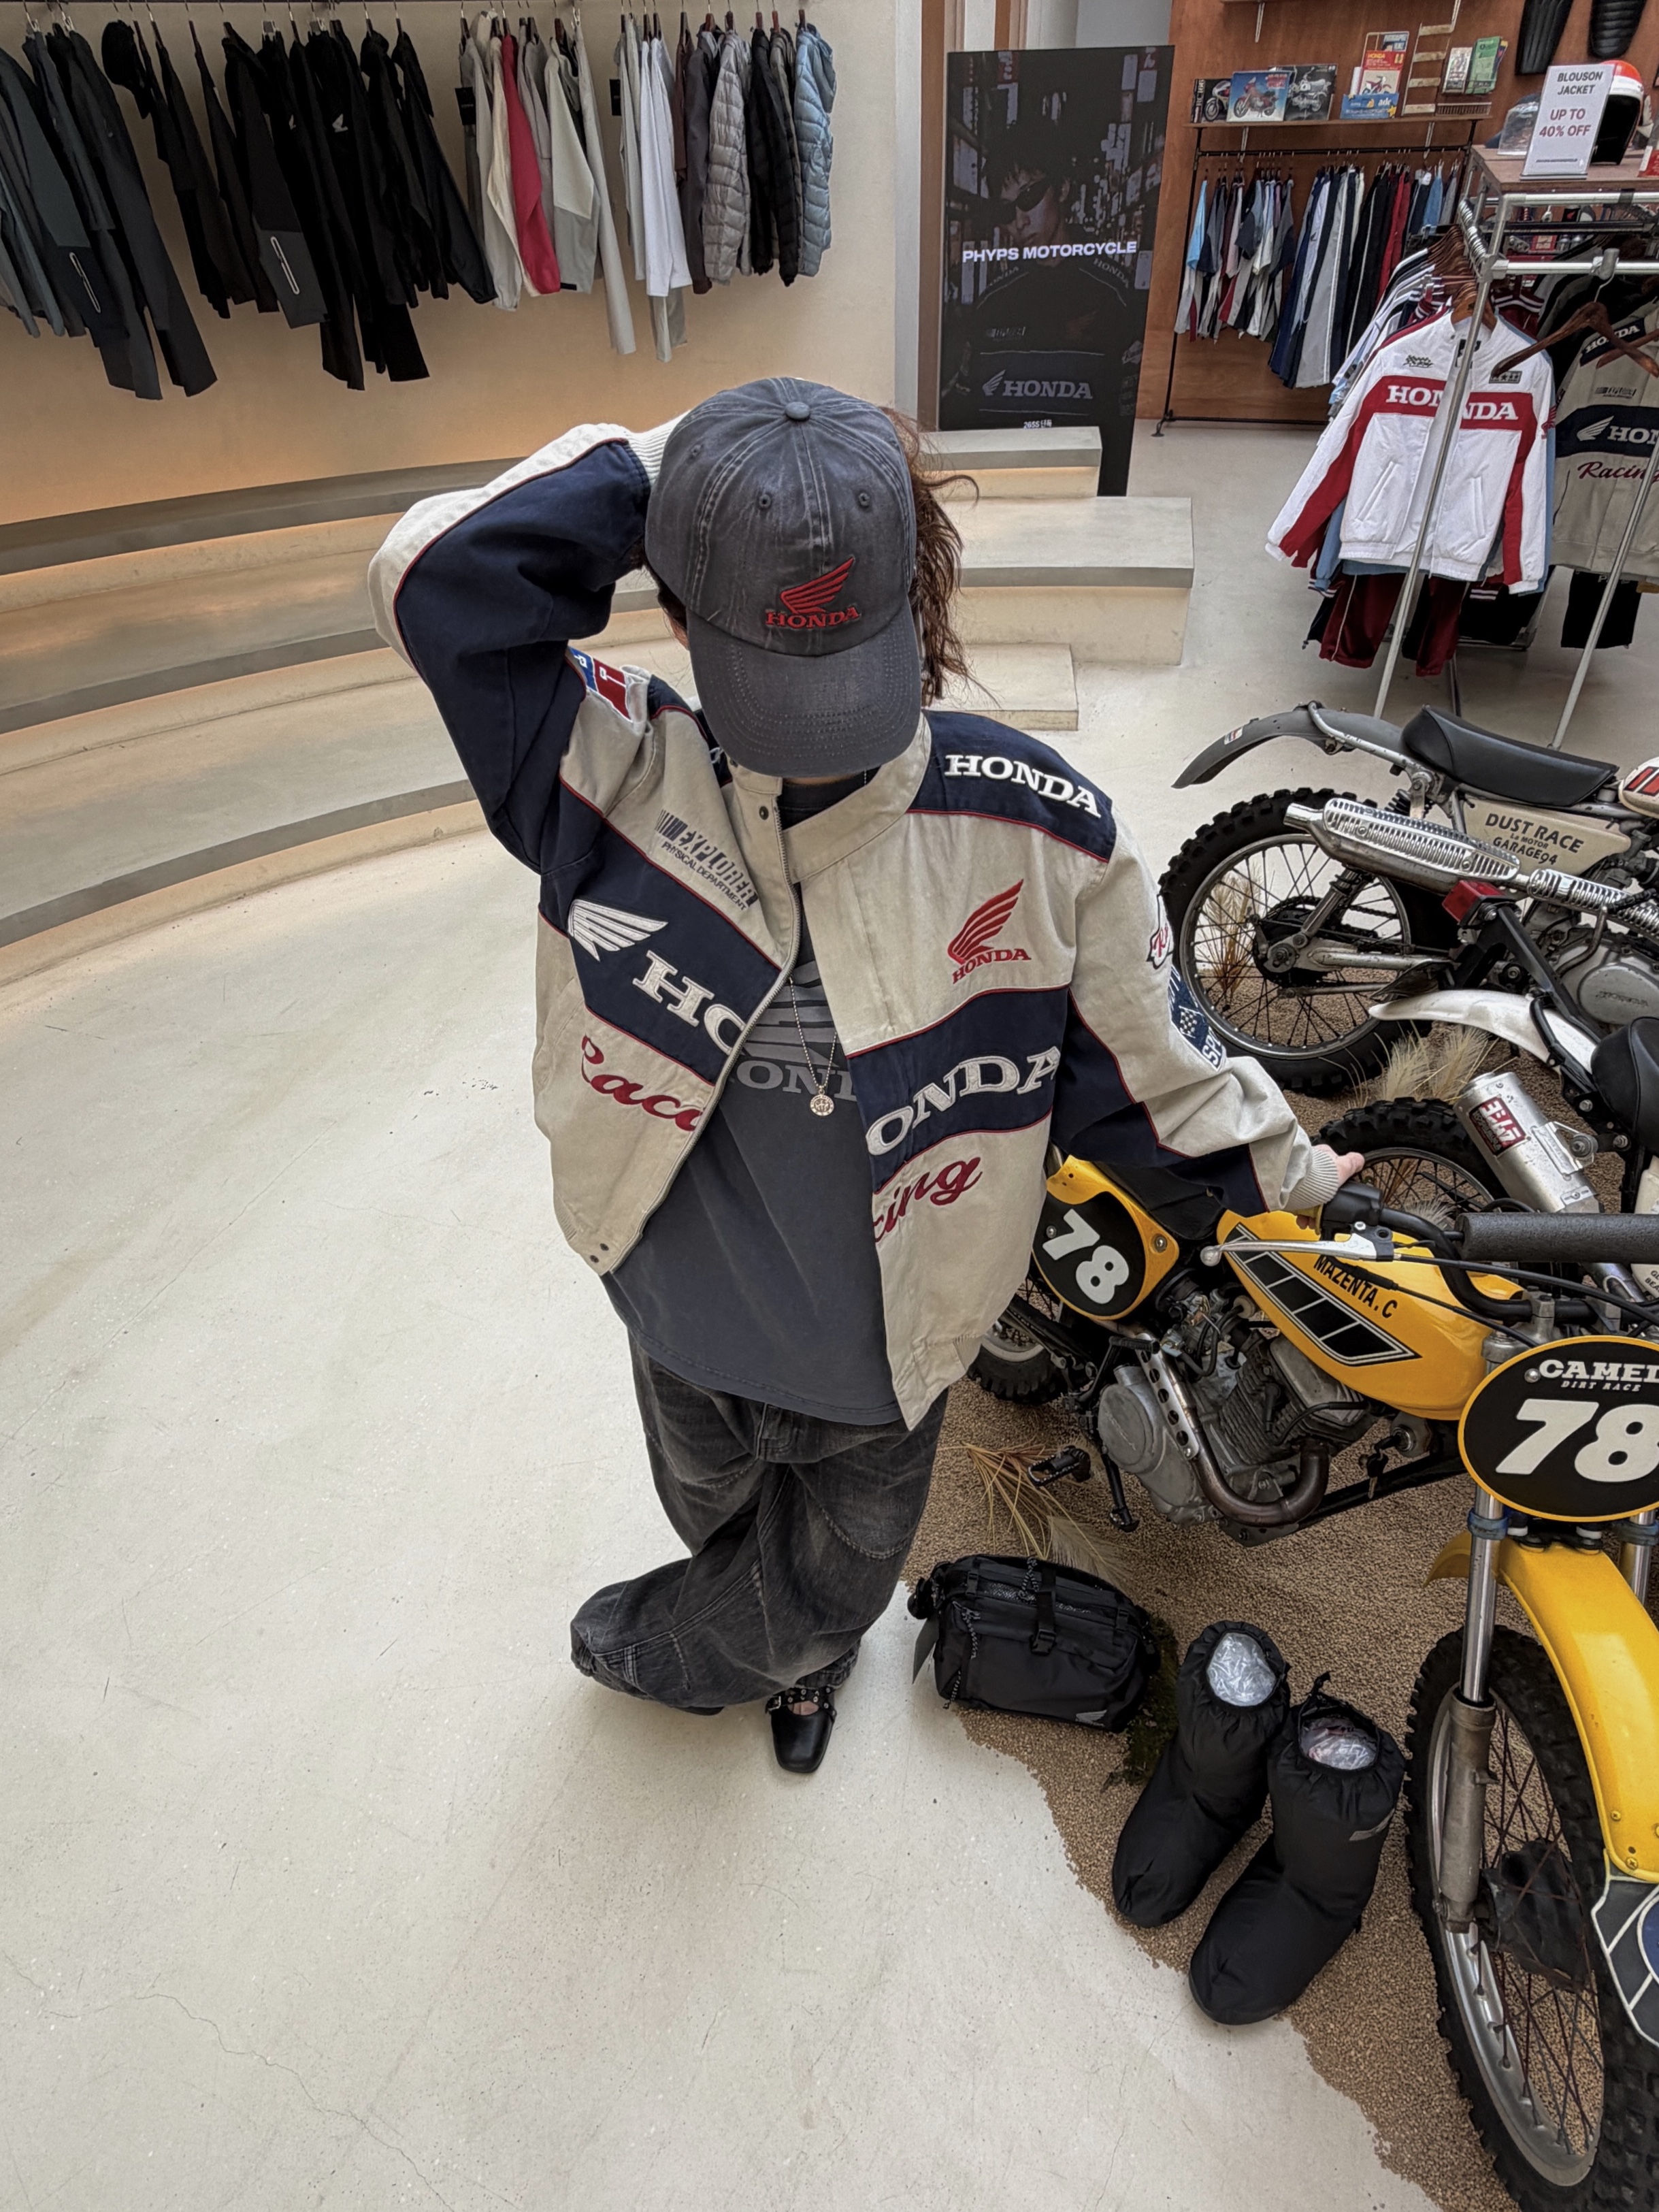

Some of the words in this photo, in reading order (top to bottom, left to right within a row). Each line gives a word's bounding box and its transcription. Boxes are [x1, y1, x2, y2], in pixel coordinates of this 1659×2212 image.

[1557, 71, 1603, 82] BLOUSON
[1558, 84, 1596, 95] JACKET
[1549, 110, 1567, 120] UP
[1570, 108, 1586, 120] TO
[1539, 125, 1564, 137] 40%
[1567, 125, 1591, 137] OFF
[963, 247, 1019, 263] PHYPS
[1023, 241, 1137, 259] MOTORCYCLE
[1092, 258, 1130, 289] HONDA
[1585, 325, 1641, 353] HODA
[1002, 380, 1093, 399] HONDA
[766, 606, 860, 630] HONDA
[945, 755, 1101, 818] HONDA
[1485, 813, 1534, 835] DUST
[1534, 826, 1584, 853] RACE
[1520, 835, 1549, 849] MOTOR
[1493, 837, 1558, 865] GARAGE94
[661, 841, 697, 871] PHYSICAL
[696, 866, 746, 911] DEPARTMENT
[952, 948, 1032, 984] HONDA
[1202, 1026, 1221, 1064] SP
[1042, 1208, 1130, 1305] 78
[1561, 1380, 1596, 1390] DIRT
[1603, 1382, 1641, 1392] RACE
[1496, 1399, 1659, 1482] 78
